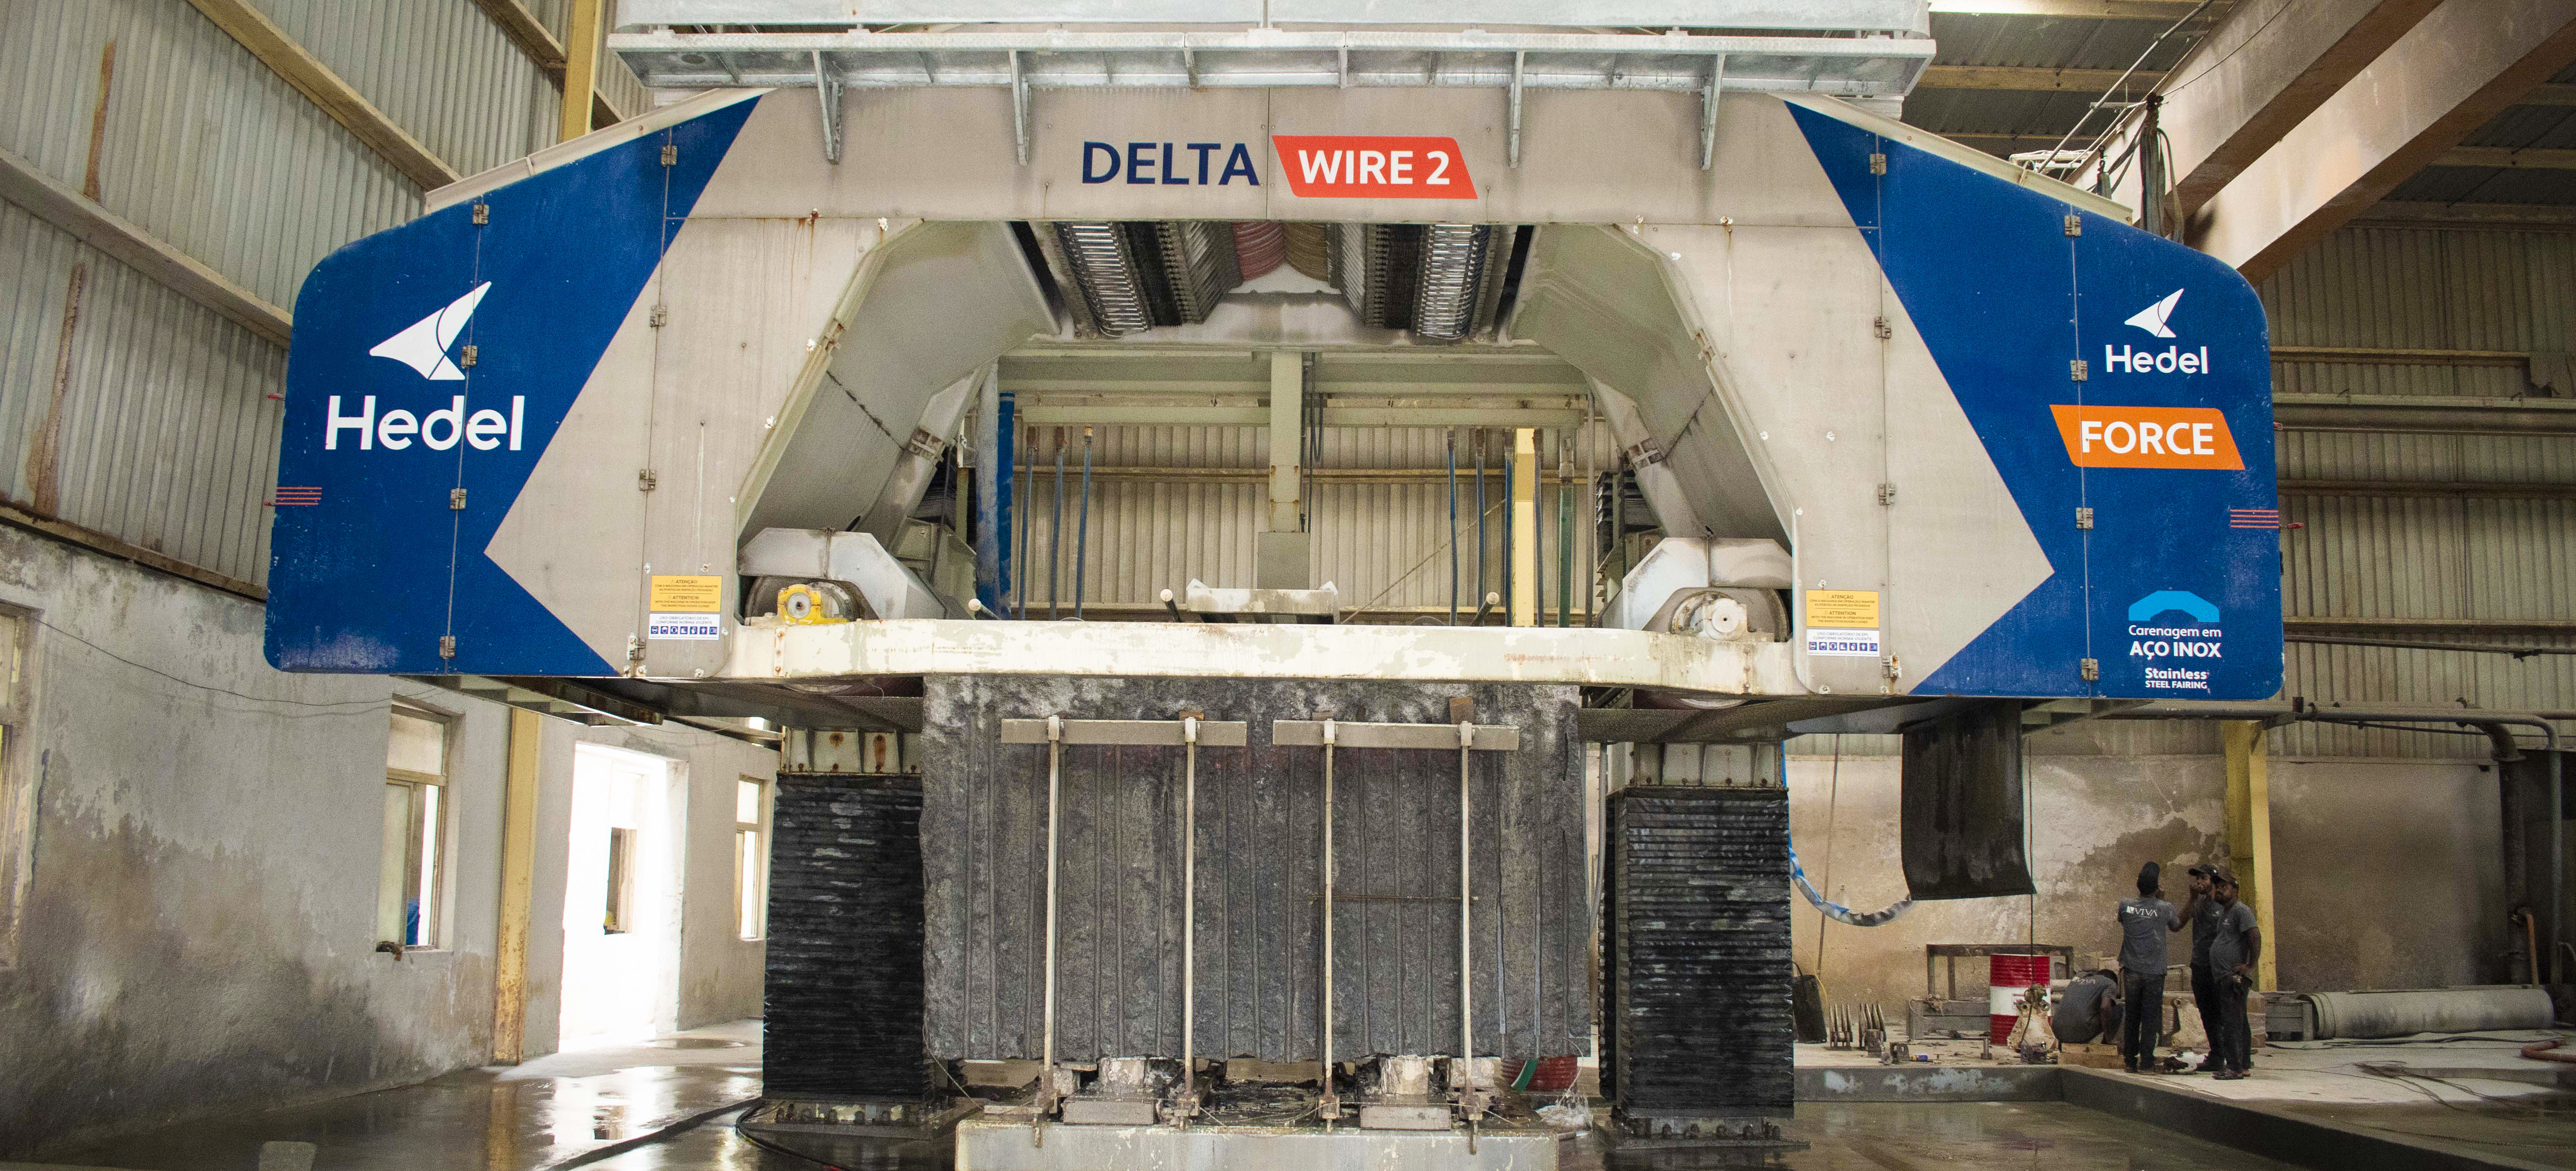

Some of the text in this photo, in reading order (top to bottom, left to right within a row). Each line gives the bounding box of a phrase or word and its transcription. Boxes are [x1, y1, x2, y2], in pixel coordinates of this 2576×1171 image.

[1082, 141, 1450, 186] DELTA WIRE 2
[2106, 345, 2209, 374] Hedel
[325, 395, 525, 451] Hedel
[2081, 421, 2214, 455] FORCE
[2128, 625, 2221, 639] Carenagem em
[2130, 641, 2222, 660] AÇO INOX
[2145, 668, 2207, 680] Stainless
[2172, 681, 2207, 689] FAIRING
[2135, 908, 2157, 916] VIVA
